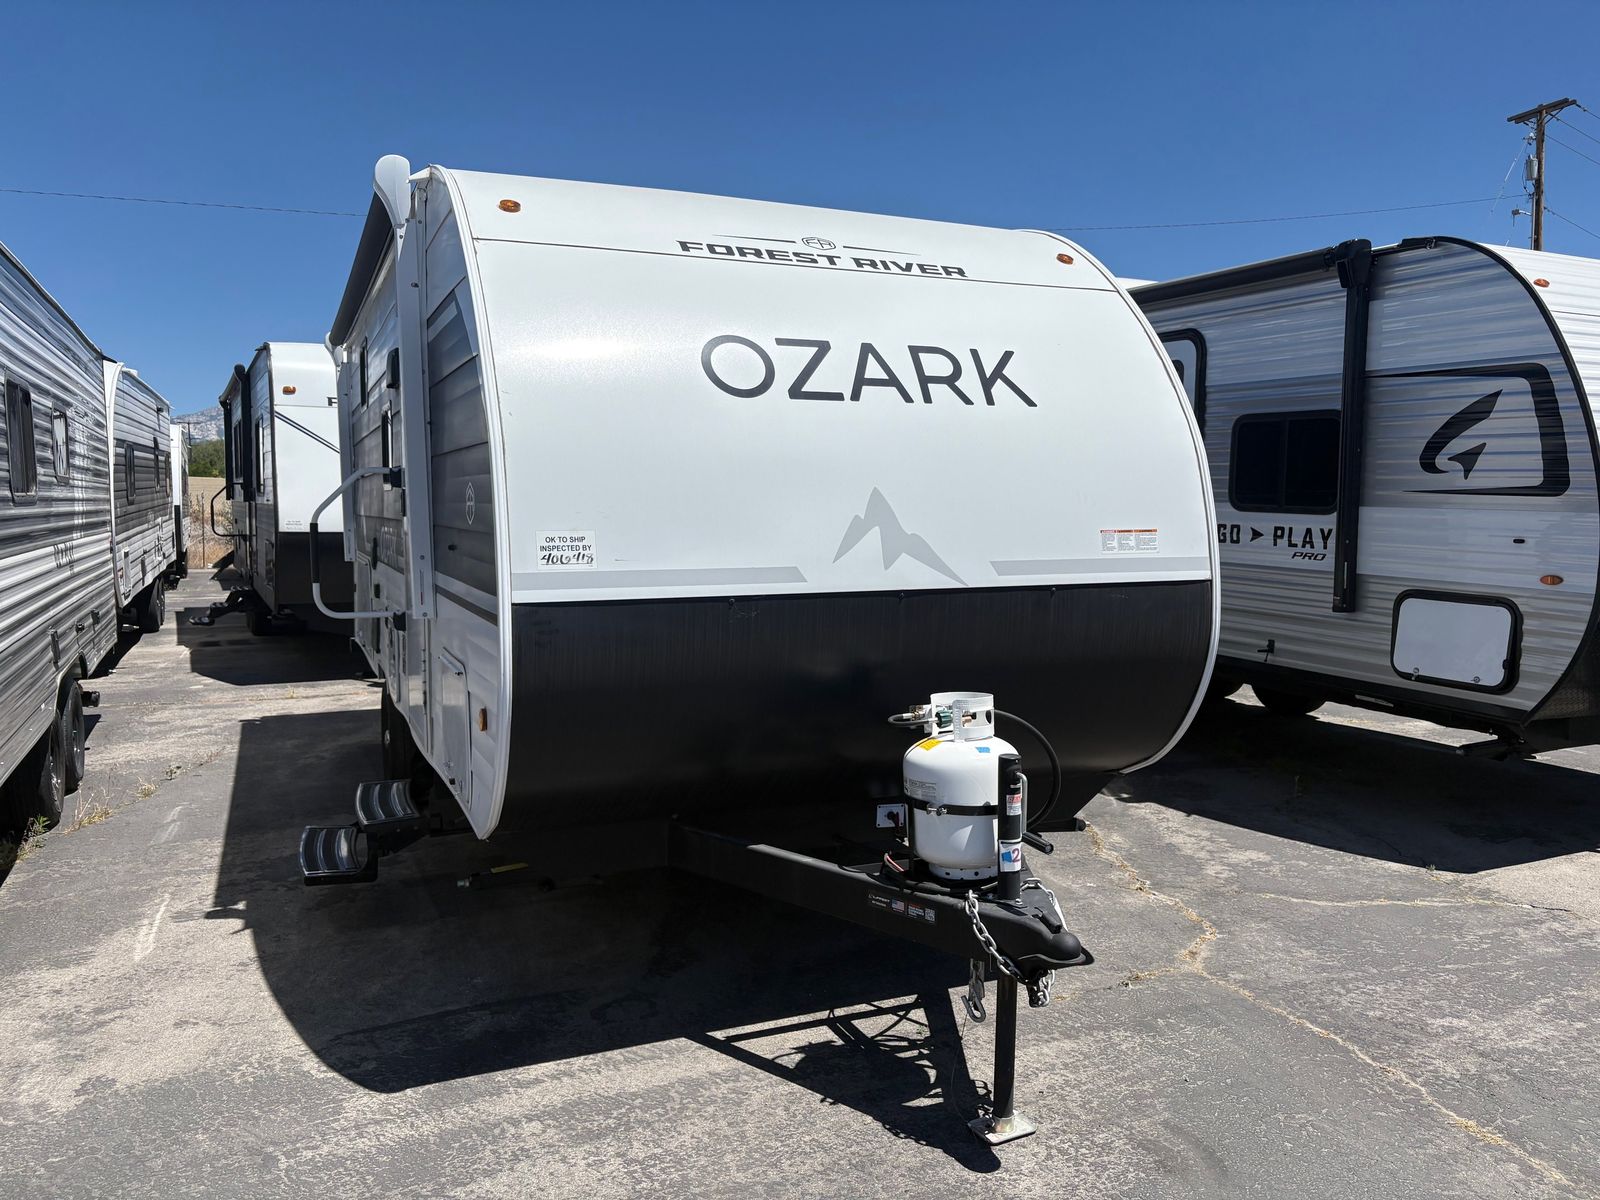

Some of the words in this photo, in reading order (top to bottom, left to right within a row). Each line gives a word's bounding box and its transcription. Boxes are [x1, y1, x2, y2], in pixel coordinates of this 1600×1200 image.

[676, 239, 841, 267] FOREST
[850, 256, 968, 278] RIVER
[701, 334, 1038, 408] OZARK
[1217, 523, 1241, 544] GO
[1272, 526, 1333, 550] PLAY
[1291, 551, 1327, 561] PRO
